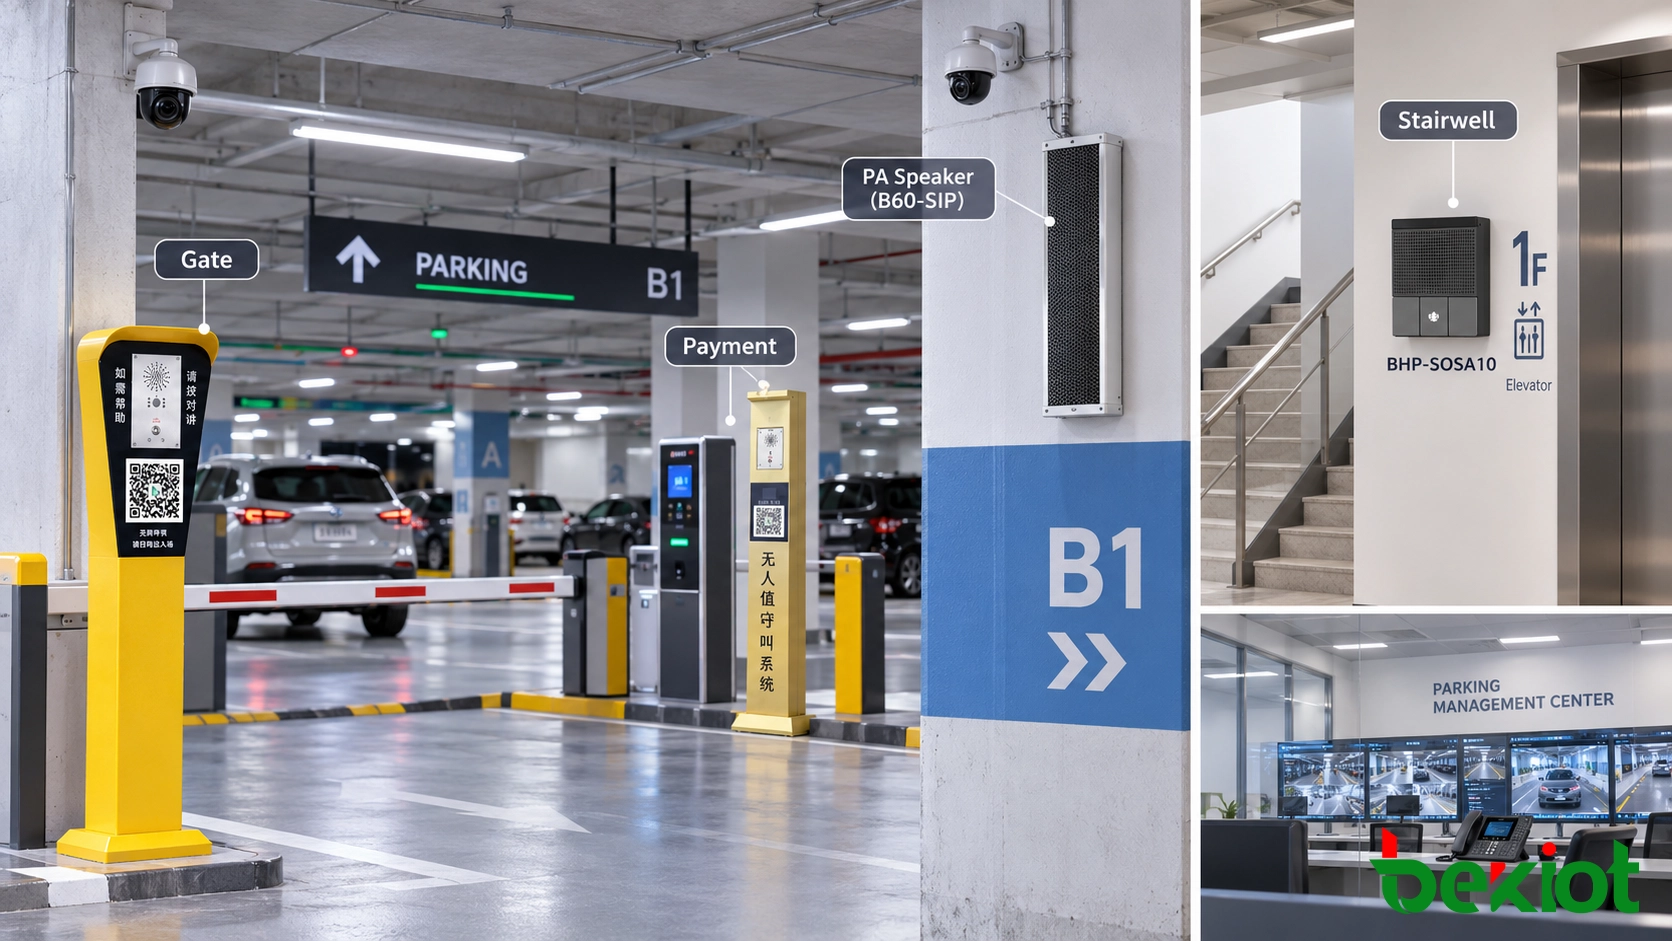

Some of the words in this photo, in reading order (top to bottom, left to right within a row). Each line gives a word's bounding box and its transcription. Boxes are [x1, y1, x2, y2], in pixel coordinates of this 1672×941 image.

[416, 251, 528, 284] PARKING
[1512, 230, 1548, 287] 1F
[647, 267, 682, 301] B1
[1506, 378, 1553, 392] Elevator
[481, 441, 502, 468] A
[1049, 527, 1142, 610] B1
[759, 551, 776, 693] 无人值守叫系统
[1433, 679, 1501, 696] PARKING
[1433, 695, 1546, 714] MANAGEMENT
[1550, 692, 1615, 708] CENTER
